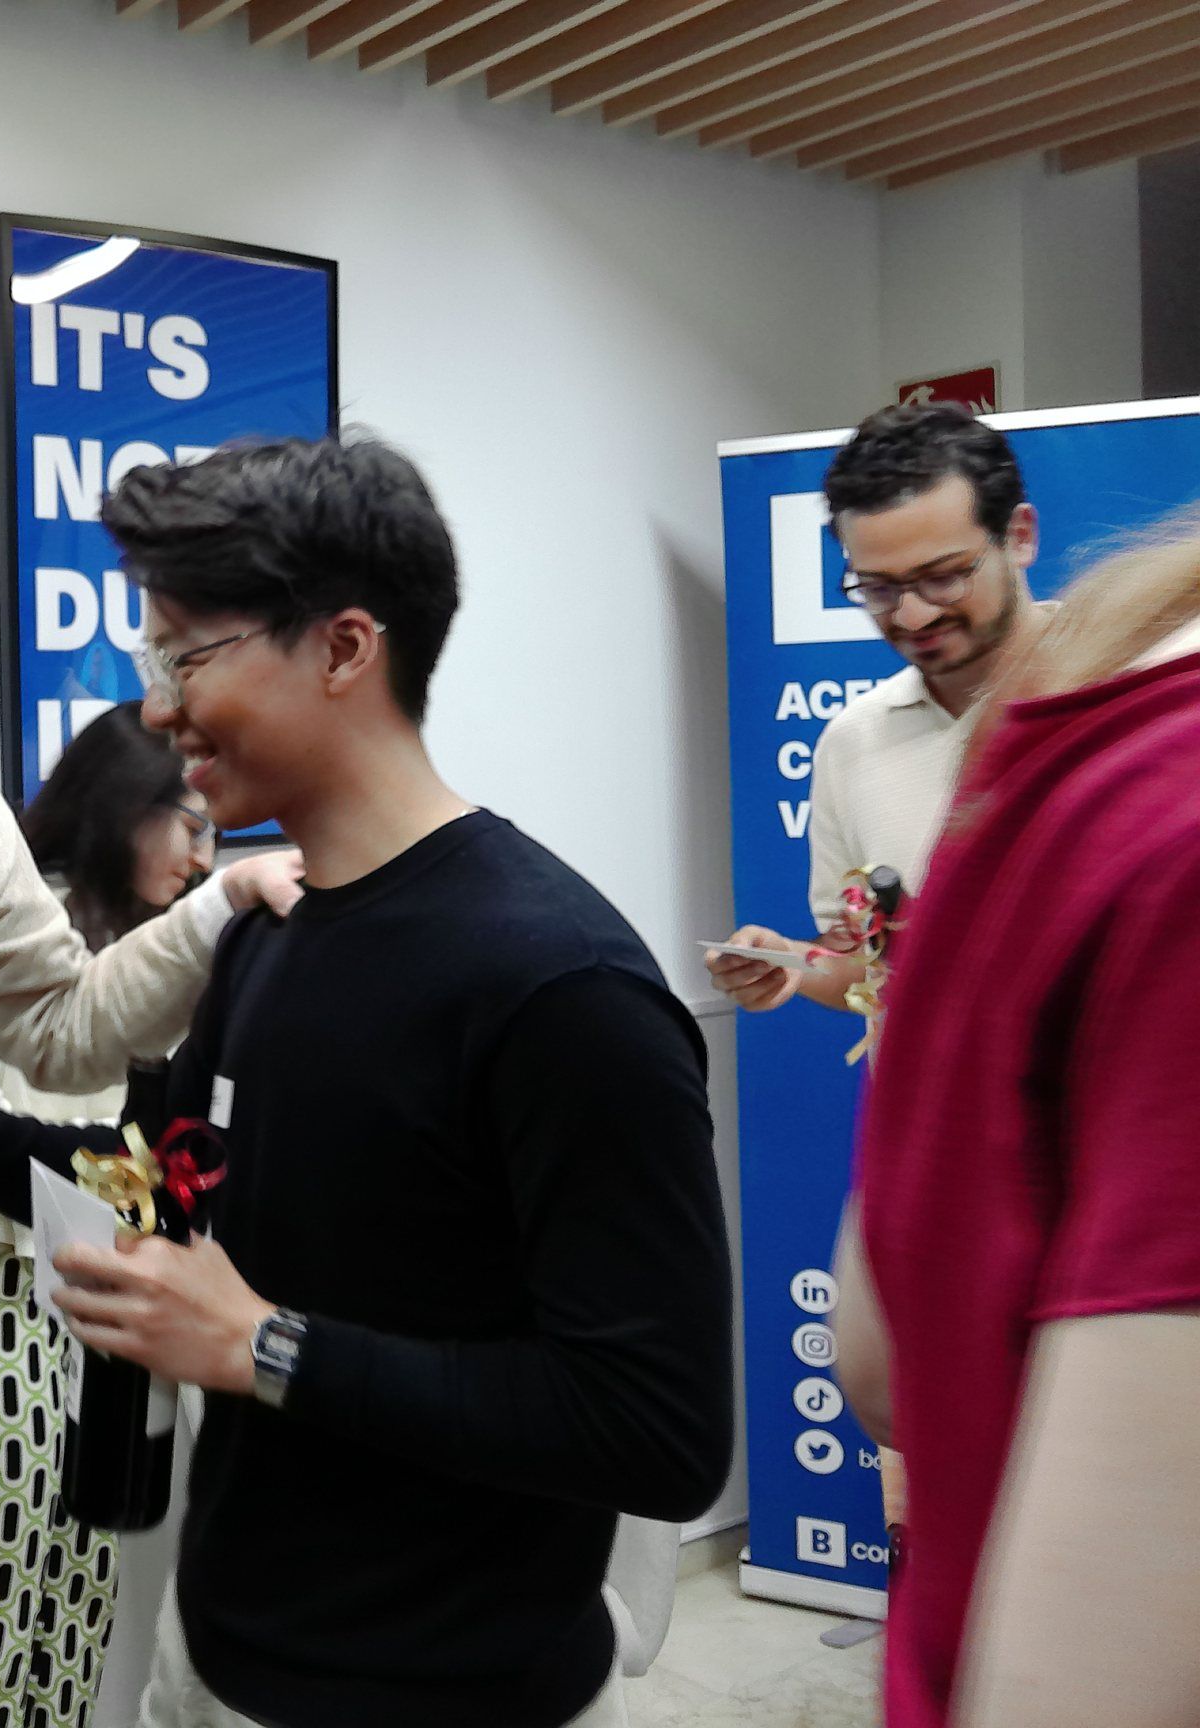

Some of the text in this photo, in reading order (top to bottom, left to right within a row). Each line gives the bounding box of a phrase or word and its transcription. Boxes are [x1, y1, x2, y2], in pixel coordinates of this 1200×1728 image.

[30, 301, 210, 401] IT'S
[803, 1278, 829, 1303] in
[811, 1529, 832, 1555] B
